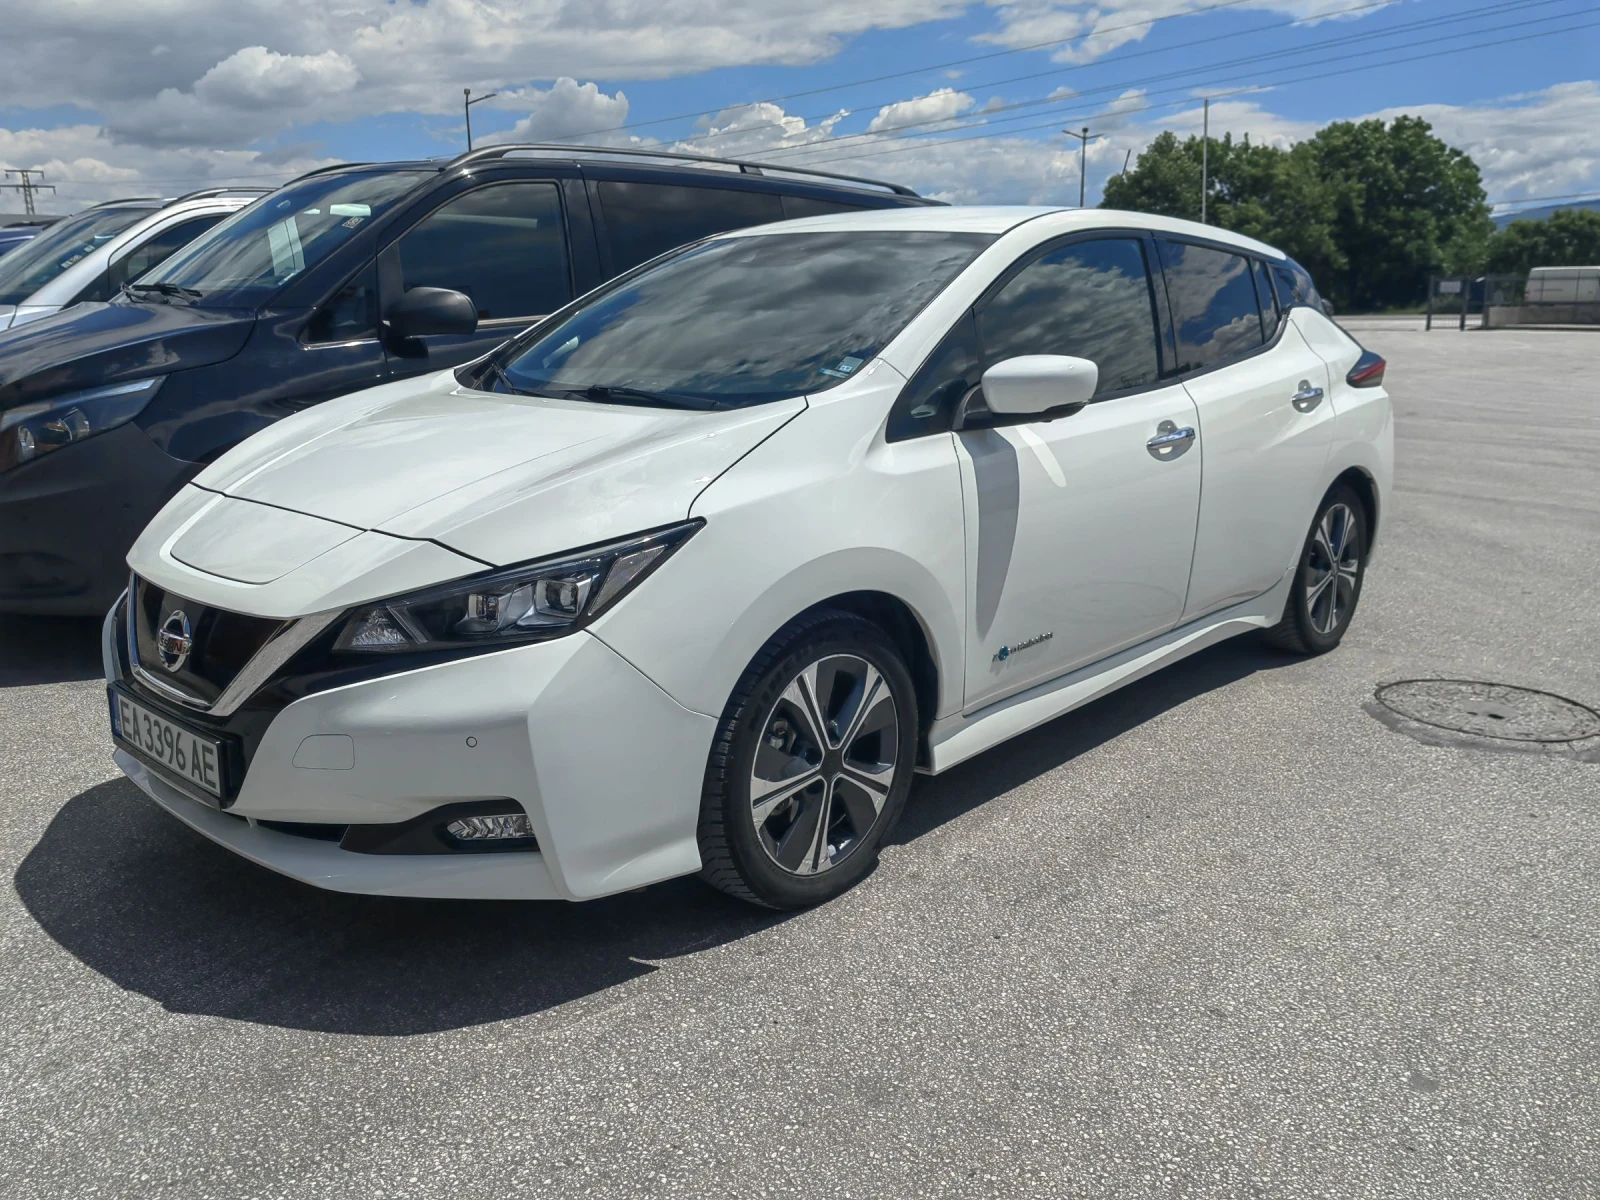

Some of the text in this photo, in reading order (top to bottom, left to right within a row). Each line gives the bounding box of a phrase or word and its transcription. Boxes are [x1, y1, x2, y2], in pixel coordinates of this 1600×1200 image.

[121, 700, 217, 789] EA 3396 AE
